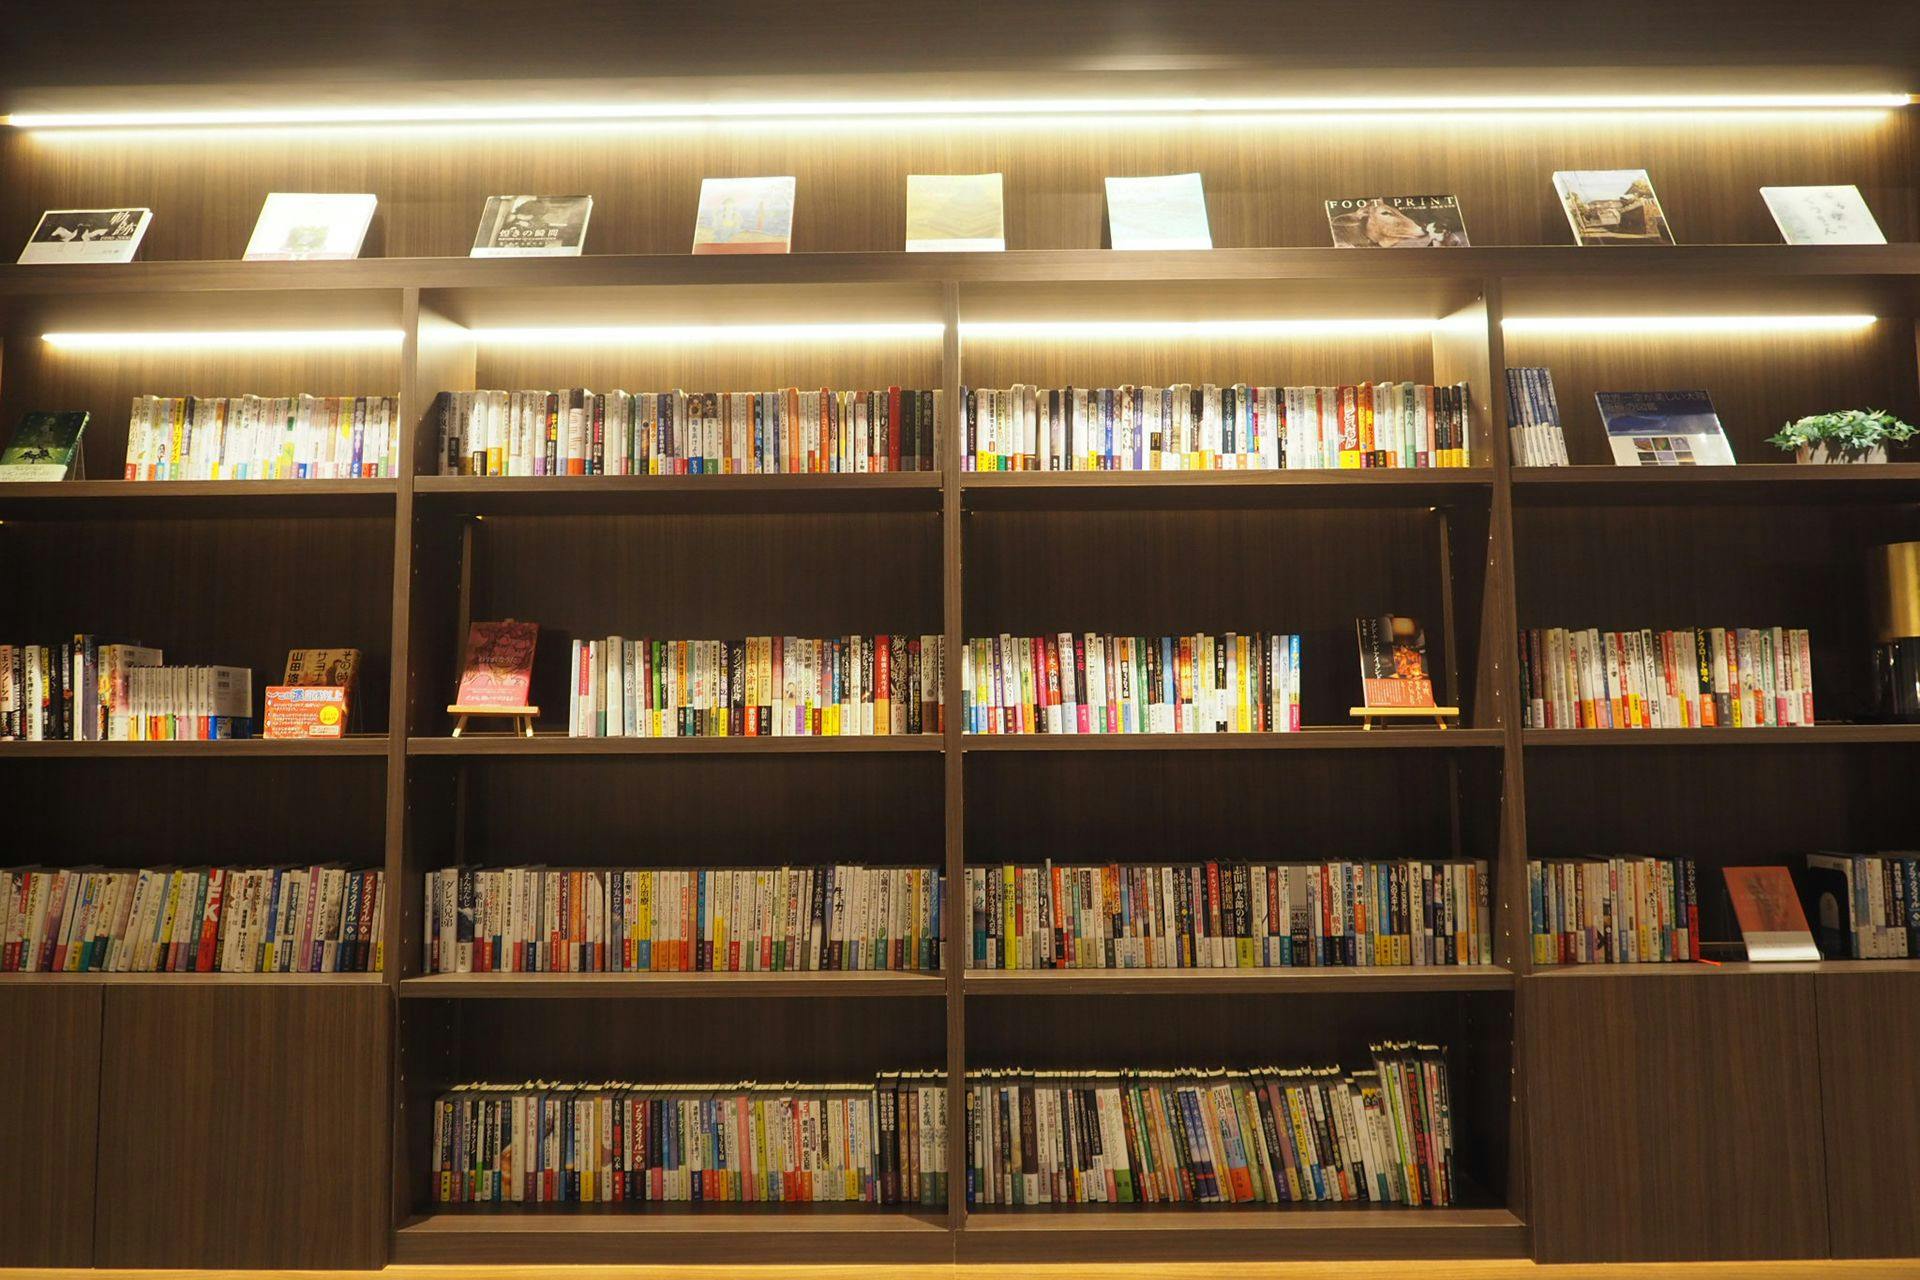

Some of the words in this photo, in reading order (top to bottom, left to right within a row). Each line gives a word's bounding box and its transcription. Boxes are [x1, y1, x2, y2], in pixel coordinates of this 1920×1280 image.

[1330, 199, 1381, 209] FOOT
[1393, 197, 1454, 207] PRINT
[288, 652, 303, 686] 山田悠
